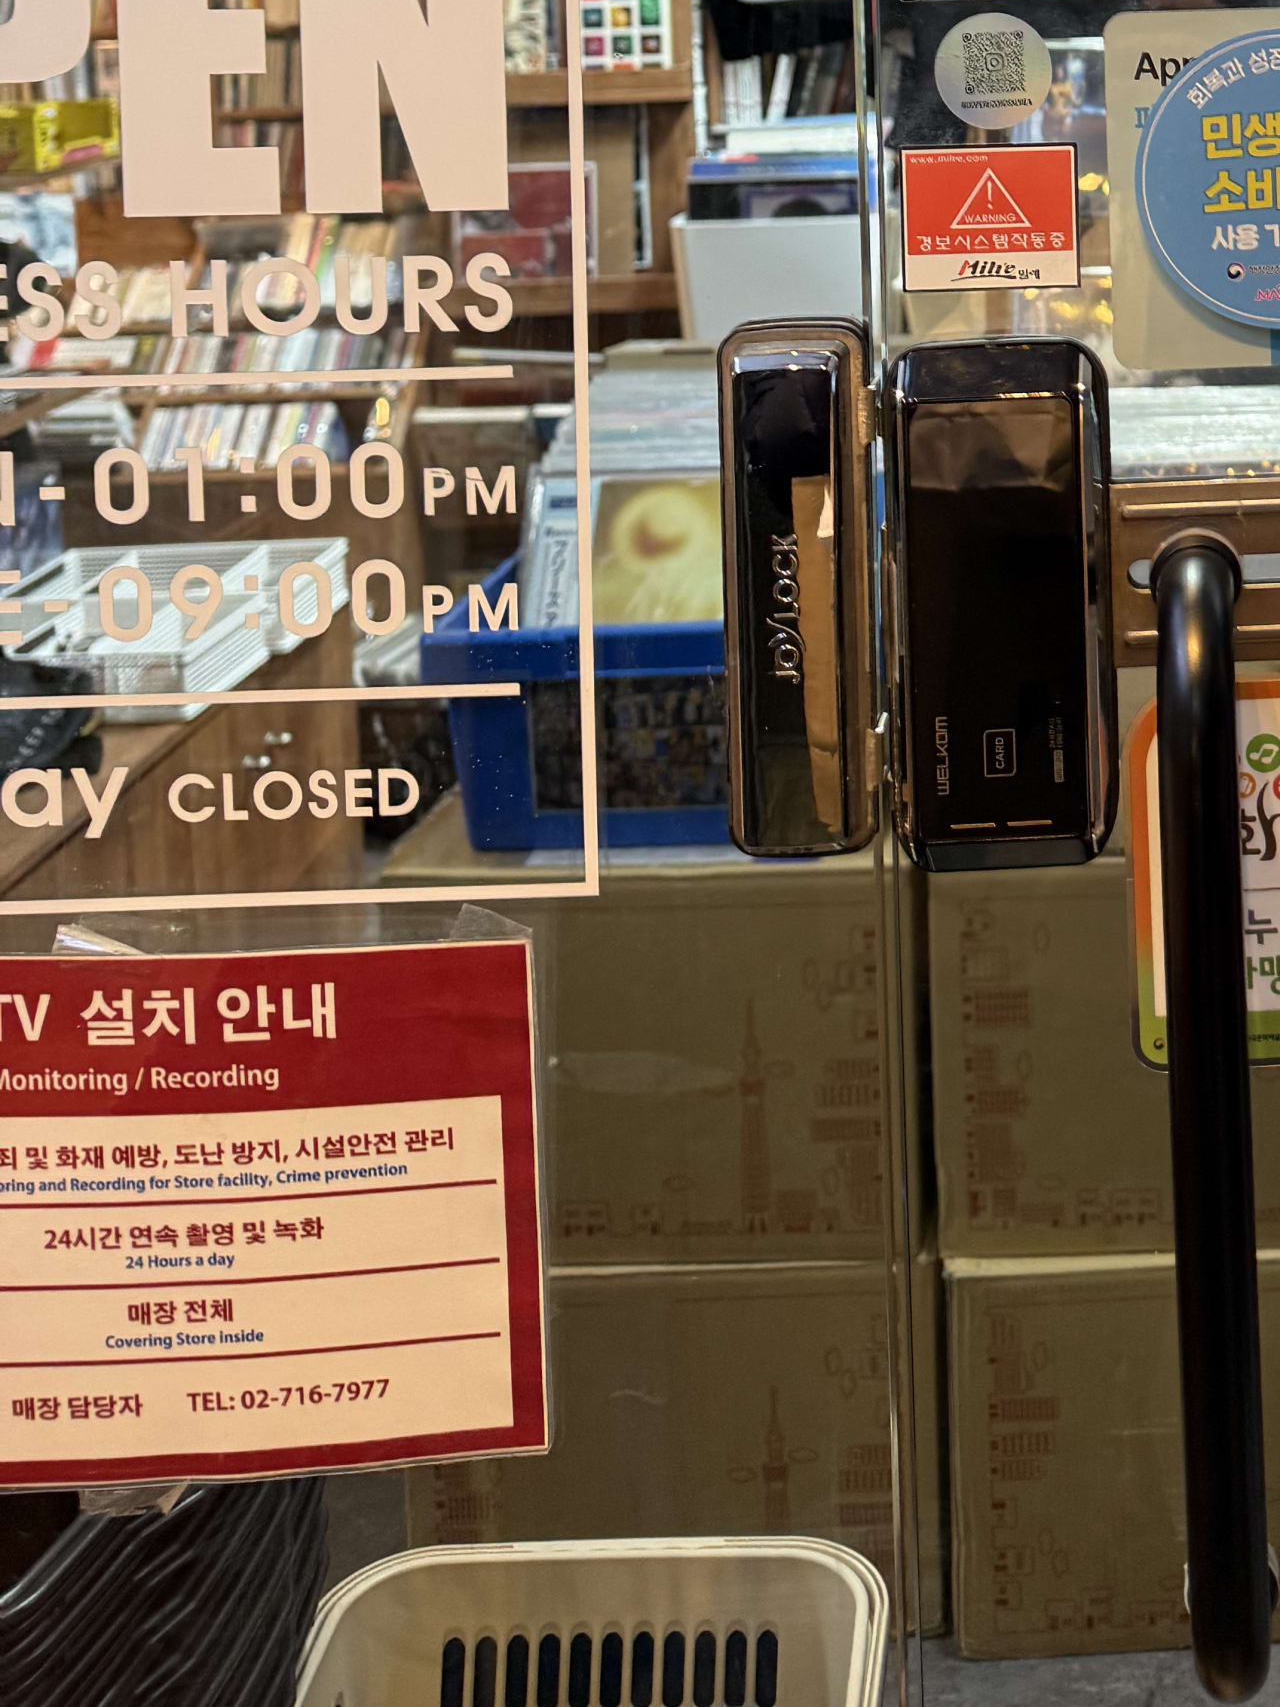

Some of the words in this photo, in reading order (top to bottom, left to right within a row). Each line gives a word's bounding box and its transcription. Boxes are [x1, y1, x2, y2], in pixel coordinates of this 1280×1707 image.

[1186, 57, 1246, 110] 회복과
[964, 213, 1016, 224] WARNING
[916, 231, 1066, 252] 경보시스템작동중
[1211, 223, 1260, 251] 사용
[0, 260, 121, 341] SS
[169, 253, 514, 337] HOURS
[937, 715, 949, 795] WELKOM
[994, 735, 1005, 770] CARD
[0, 766, 129, 838] ay
[168, 769, 420, 822] CLOSED
[80, 988, 196, 1046] 설치
[217, 983, 337, 1042] 안내
[151, 1065, 280, 1092] Recording
[25, 1146, 48, 1170] 및
[56, 1145, 104, 1169] 화재
[112, 1144, 168, 1169] 예방,
[174, 1142, 224, 1166] 도난
[232, 1139, 289, 1165] 방지,
[296, 1132, 397, 1160] 시설안전
[404, 1127, 454, 1152] 관리
[70, 1177, 146, 1193] Recording
[174, 1175, 213, 1188] Store
[218, 1172, 273, 1188] facility,
[276, 1170, 321, 1184] Crime
[325, 1164, 408, 1184] prevention
[44, 1226, 122, 1250] 24시간
[129, 1225, 179, 1249] 연속
[186, 1222, 235, 1246] 촬영
[243, 1220, 266, 1244] 및
[273, 1217, 324, 1241] 녹화
[148, 1255, 192, 1268] Hours
[207, 1252, 235, 1268] day
[128, 1302, 177, 1325] 매장
[184, 1299, 234, 1323] 전체
[105, 1332, 172, 1349] Covering
[176, 1330, 216, 1346] Store
[219, 1328, 264, 1343] inside
[11, 1397, 60, 1421] 매장
[68, 1394, 143, 1421] 담당자
[187, 1391, 236, 1413] TEL:
[240, 1378, 390, 1410] 02-716-7977
